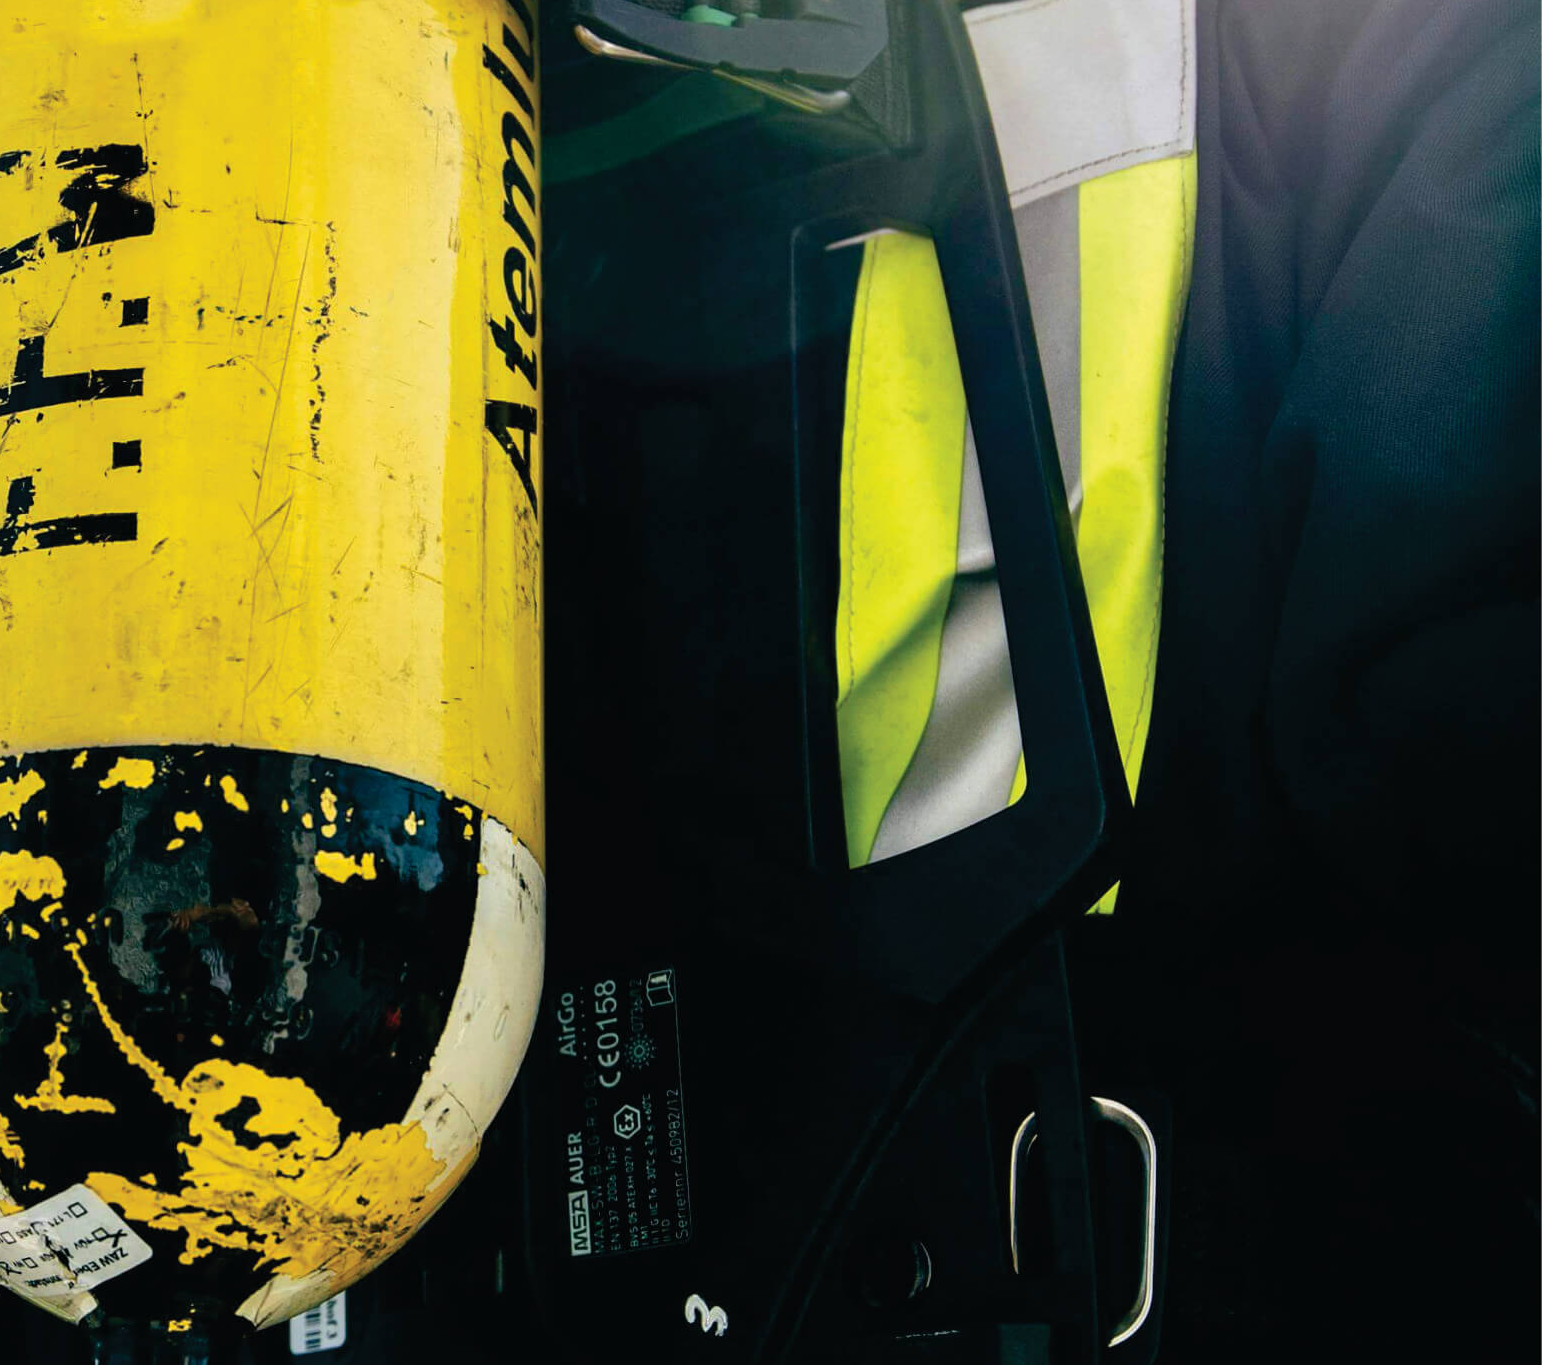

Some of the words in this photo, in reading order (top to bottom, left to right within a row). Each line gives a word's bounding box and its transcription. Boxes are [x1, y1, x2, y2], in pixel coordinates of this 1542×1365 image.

[557, 992, 577, 1056] AirGo
[568, 1131, 584, 1185] AUER
[570, 1191, 591, 1254] MSA
[100, 1246, 129, 1267] ZAW
